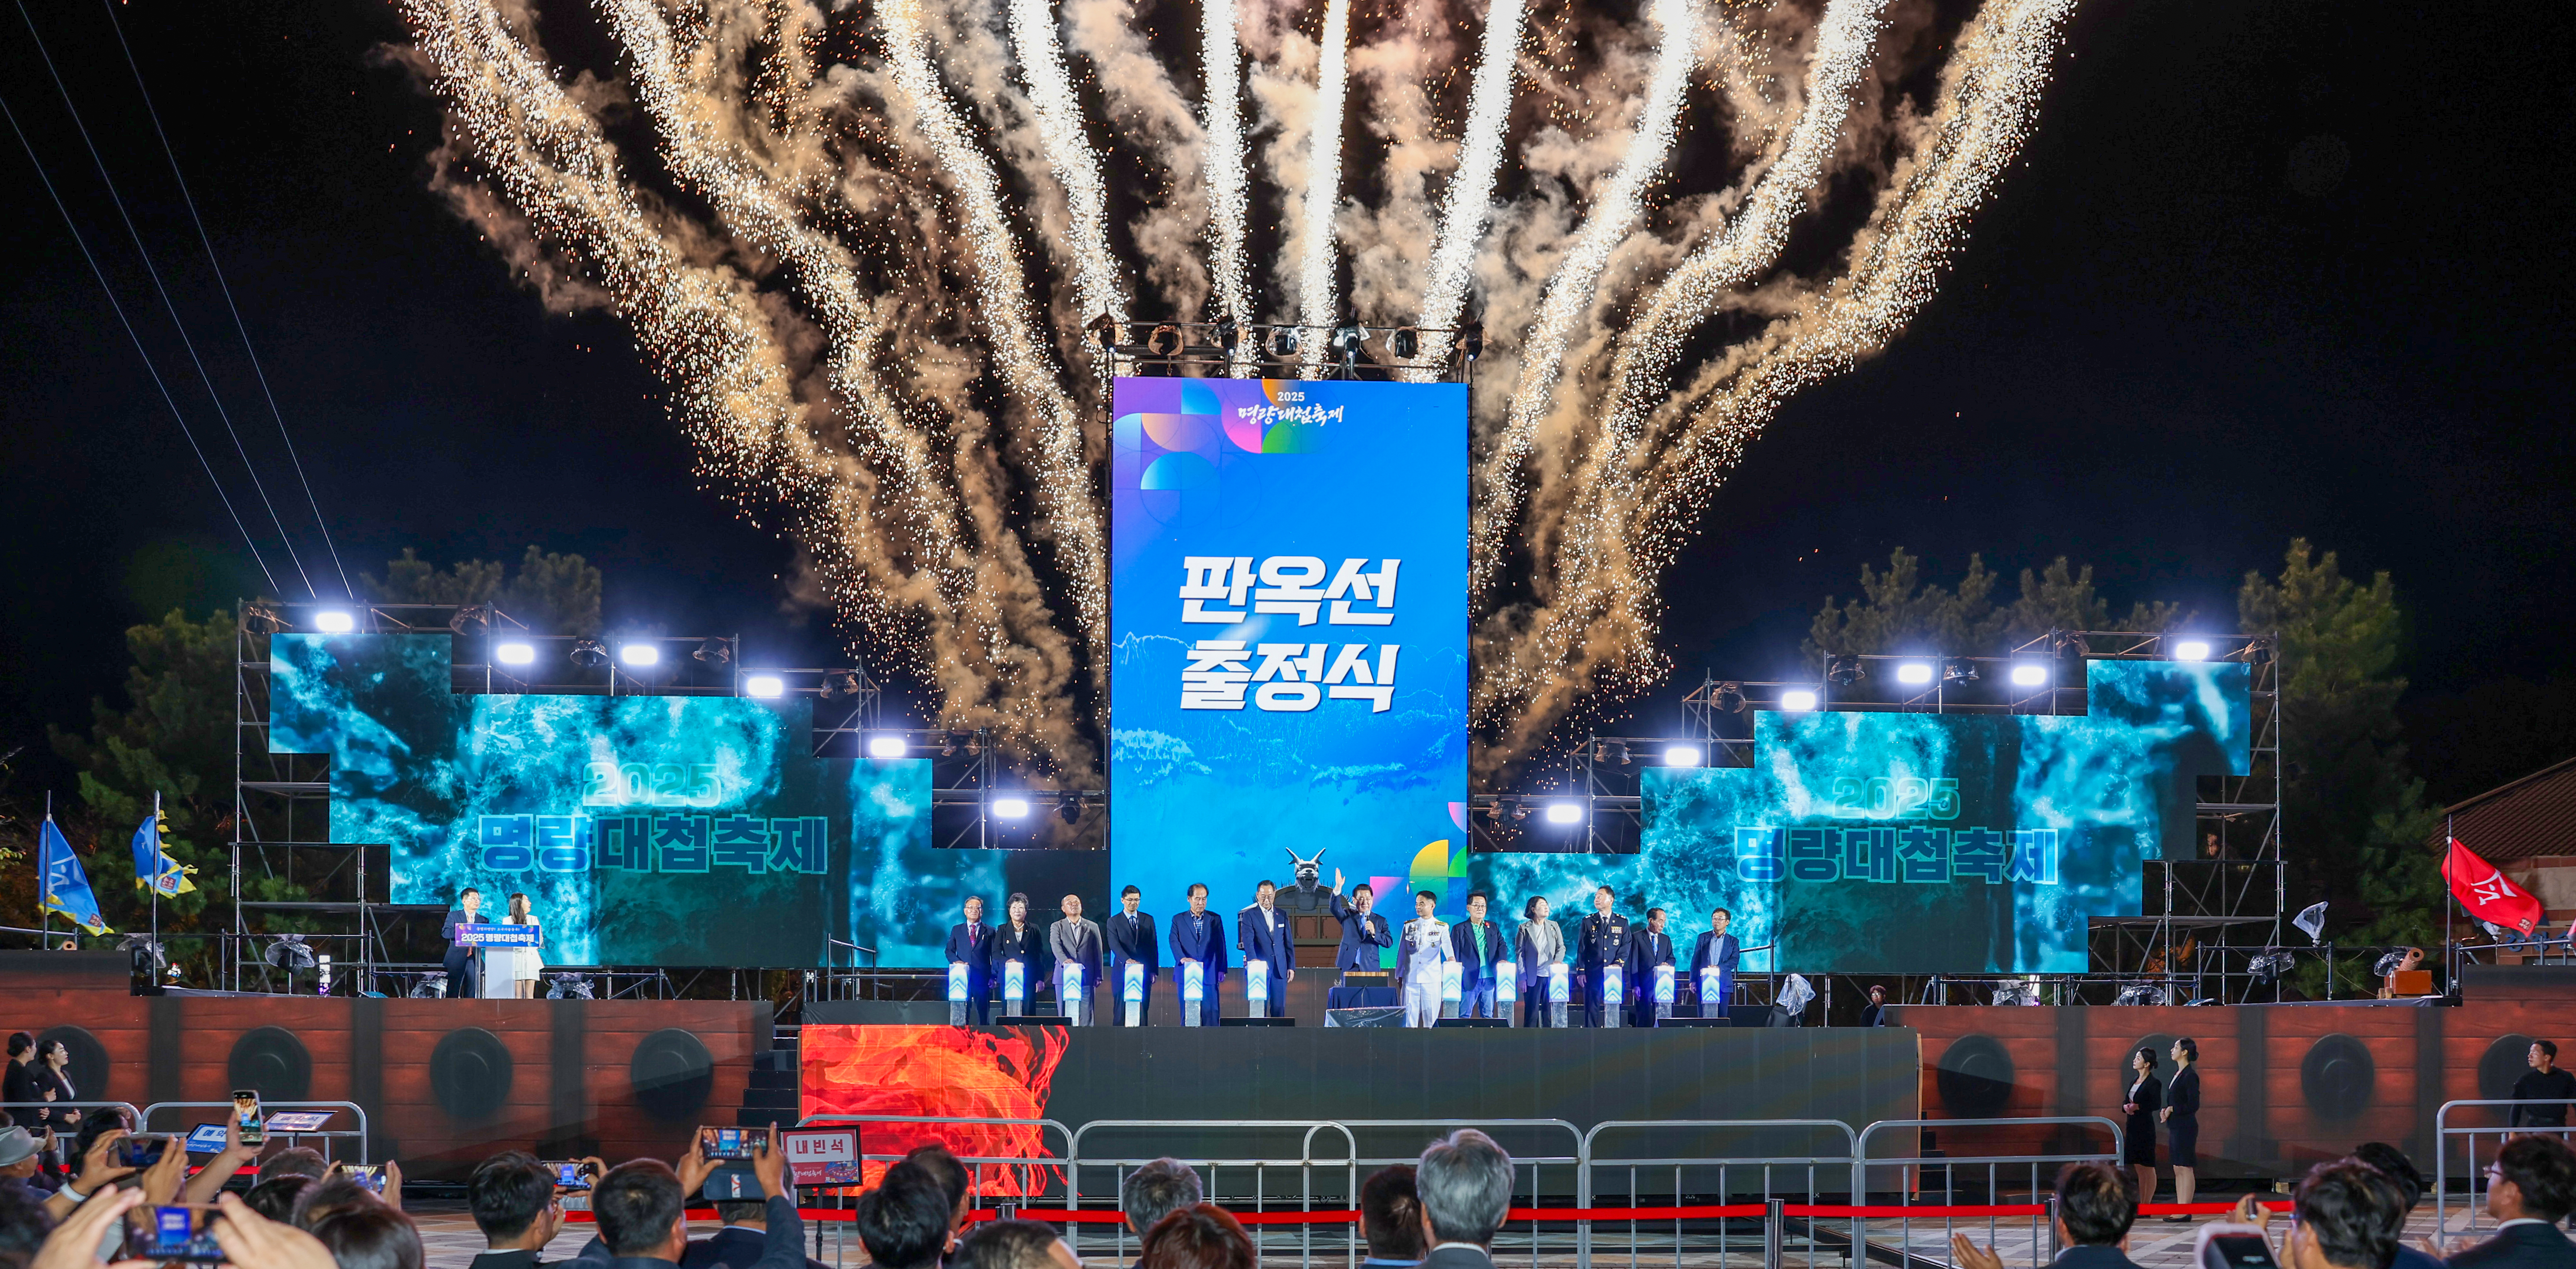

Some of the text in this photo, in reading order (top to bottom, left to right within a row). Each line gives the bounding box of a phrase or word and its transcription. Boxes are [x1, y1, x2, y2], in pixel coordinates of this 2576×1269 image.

[1238, 403, 1344, 427] 명량대첩축제
[1278, 392, 1305, 401] 2025
[1179, 556, 1401, 626] 판옥선
[1180, 640, 1401, 712] 출정식
[583, 762, 721, 807] 2025
[1832, 776, 1961, 820] 2025
[478, 813, 828, 874] 명량대첩축제
[1734, 826, 2058, 885] 명량대첩축제
[461, 933, 534, 942] 2025 명량대첩축제
[796, 1139, 843, 1154] 내빈석
